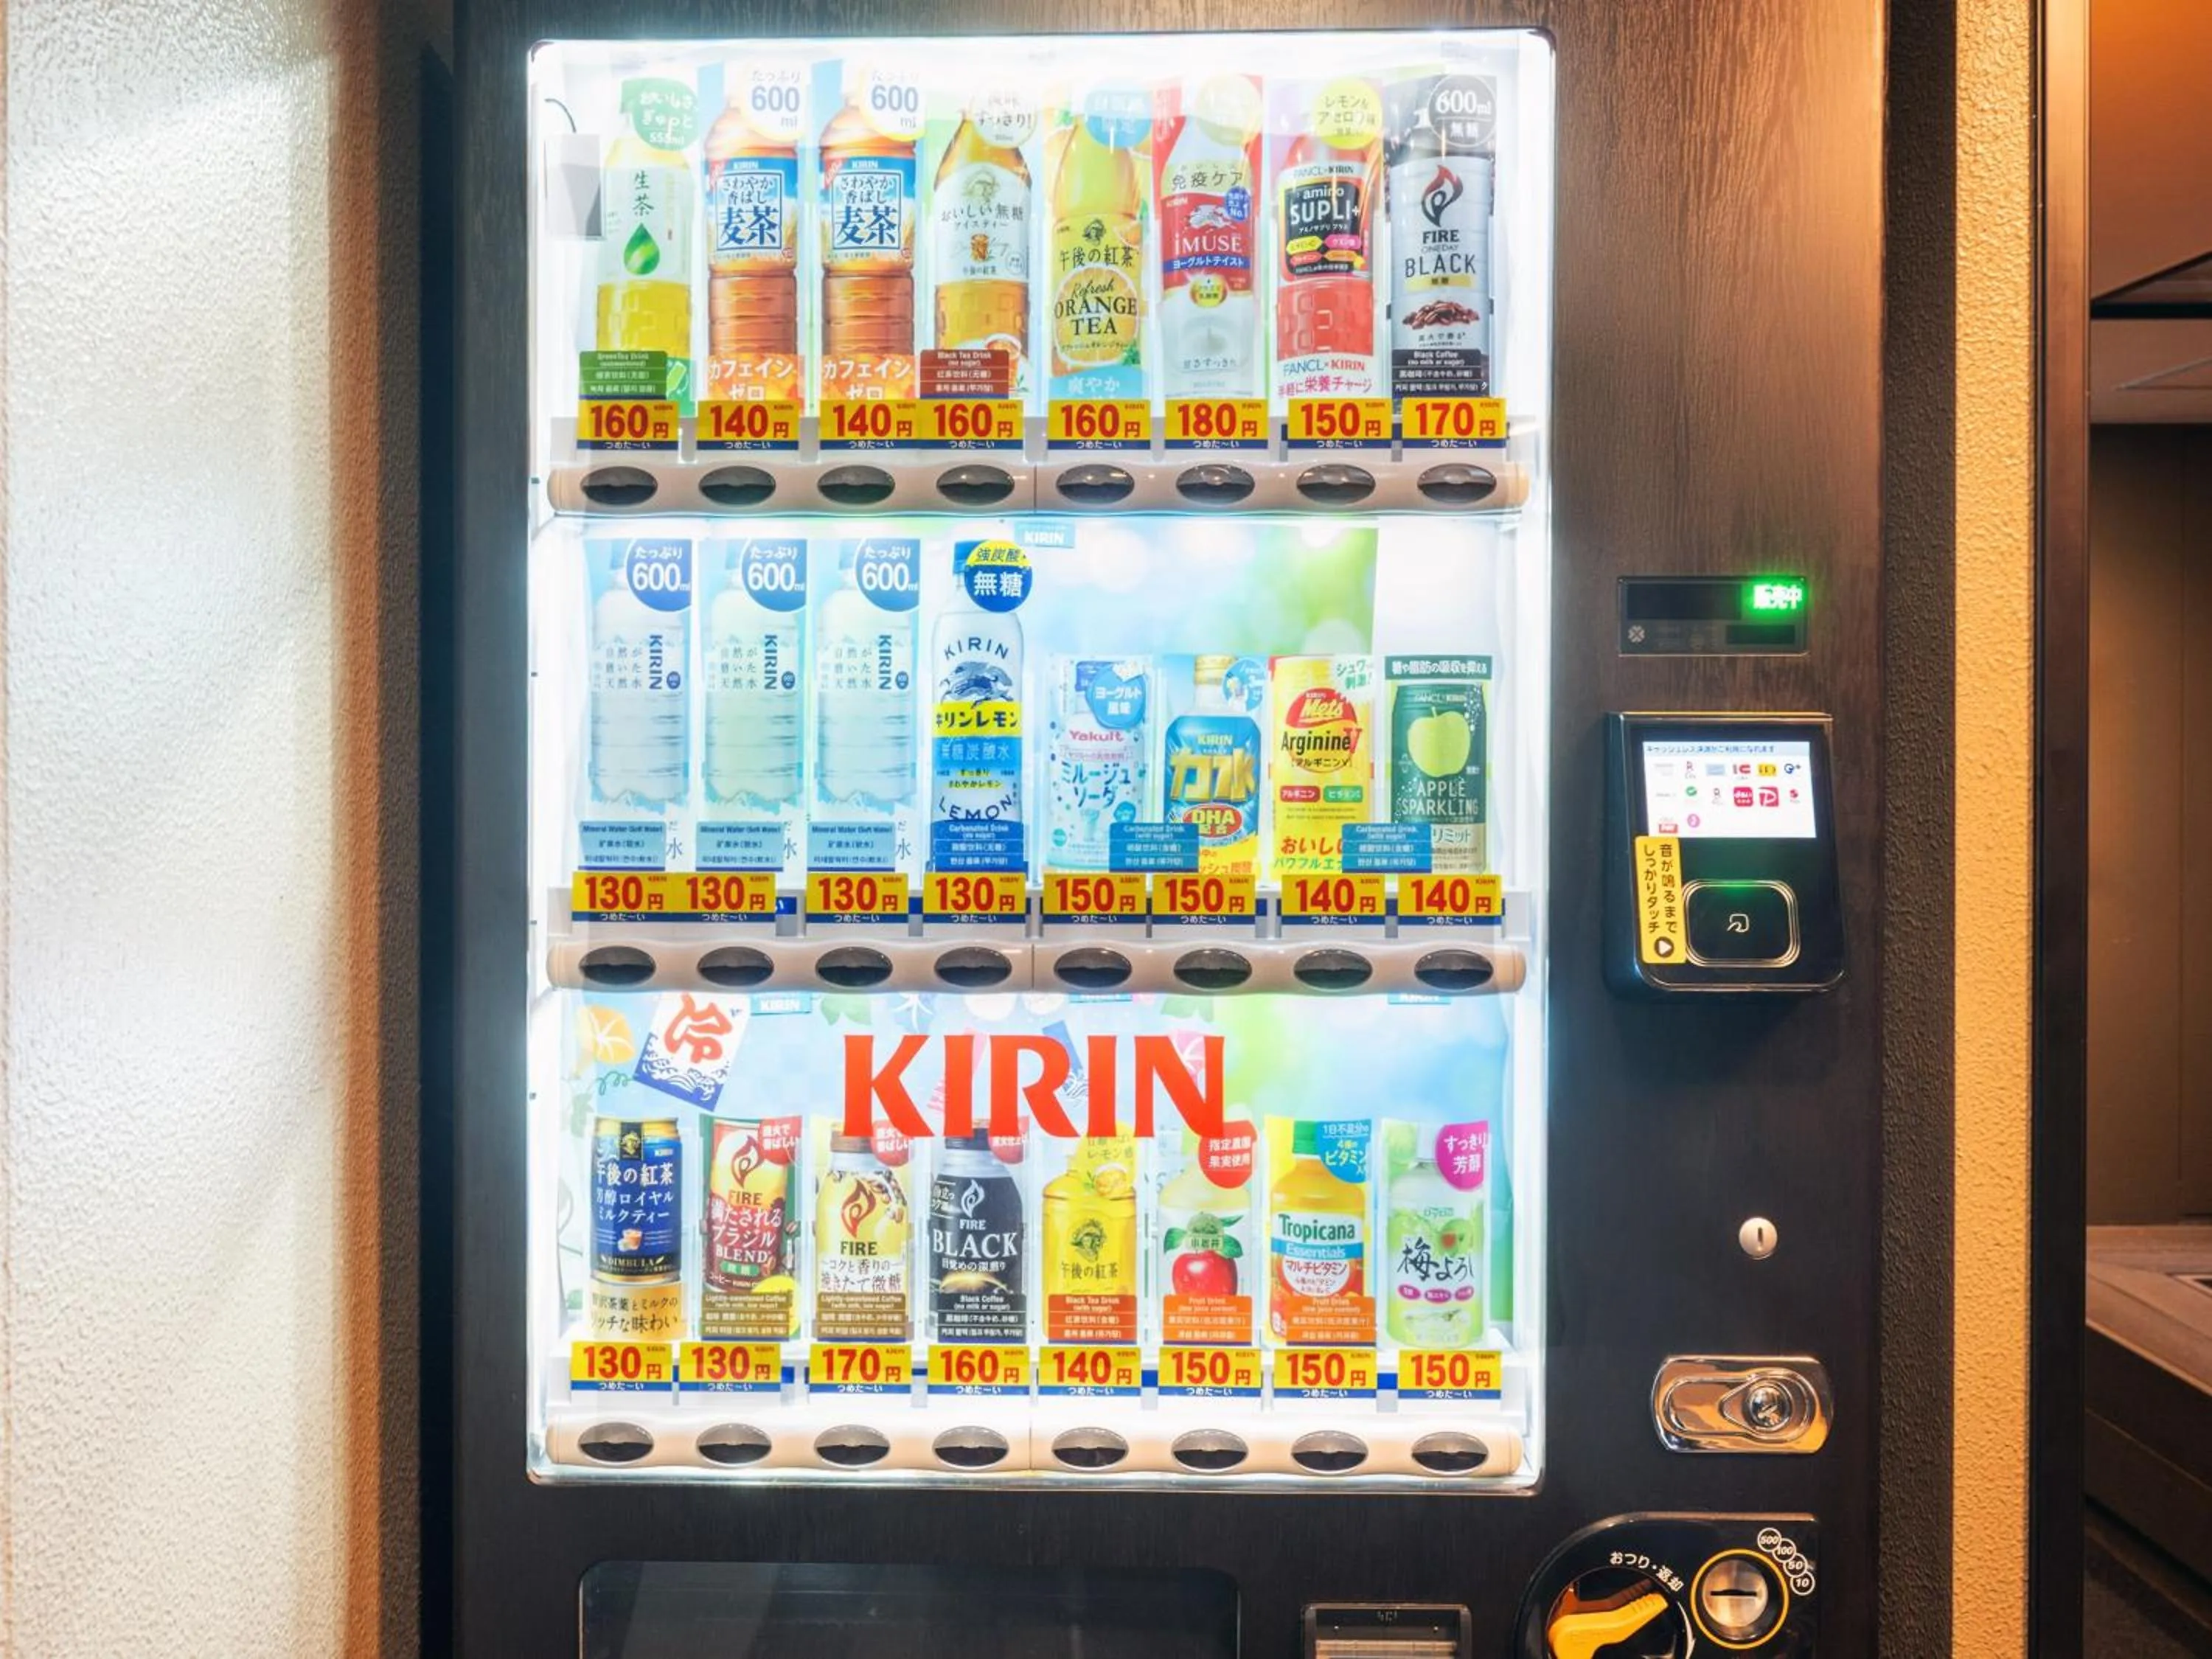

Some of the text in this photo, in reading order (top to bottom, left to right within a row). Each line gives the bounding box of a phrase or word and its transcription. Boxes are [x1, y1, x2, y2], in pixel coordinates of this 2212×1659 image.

[751, 85, 801, 113] 600
[871, 85, 919, 113] 600
[733, 161, 759, 170] KIRIN
[852, 160, 878, 170] KIRIN
[1171, 171, 1243, 190] 免疫ケア
[633, 169, 655, 218] 生茶
[718, 205, 779, 246] 麦茶
[835, 205, 897, 245] 麦茶
[1422, 229, 1461, 244] FIRE
[1174, 233, 1243, 256] iMUSE
[1060, 245, 1136, 271] 午後の紅茶
[1172, 255, 1244, 271] ヨーグルトテイスト
[1405, 253, 1477, 278] BLACK
[1054, 295, 1138, 319] ORANGE
[1071, 317, 1118, 335] TEA
[708, 358, 794, 379] カフェイン
[823, 359, 911, 379] カフェイン
[1330, 359, 1366, 372] KIRIN
[728, 385, 765, 400] ゼロ
[846, 384, 883, 400] ゼロ
[1068, 376, 1120, 394] 爽やか
[591, 405, 669, 438] 160円
[711, 405, 789, 438] 140円
[833, 404, 912, 437] 140円
[934, 404, 1013, 437] 160円
[1061, 404, 1141, 437] 160円
[1178, 403, 1257, 437] 180円
[1301, 403, 1382, 437] 150円
[1416, 403, 1496, 437] 170円
[1024, 530, 1065, 543] KIRIN
[635, 546, 683, 560] たっぷり
[749, 546, 798, 560] たっぷり
[863, 546, 911, 560] たっぷり
[975, 547, 1019, 563] 強炭酸
[973, 570, 1023, 597] 無糖
[943, 636, 1009, 660] KIRIN
[649, 634, 664, 690] KIRIN
[764, 634, 778, 690] KIRIN
[878, 634, 892, 690] KIRIN
[1095, 686, 1142, 700] ヨーグルト
[936, 710, 1018, 728] キリンレモン
[1069, 729, 1124, 742] Yakult
[1196, 734, 1233, 745] KIRIN
[1074, 785, 1119, 808] ソーダ
[1416, 779, 1467, 798] APPLE
[938, 793, 1014, 821] LEMON
[1191, 810, 1236, 825] DHA
[585, 876, 663, 910] 130円
[686, 876, 765, 910] 130円
[818, 877, 897, 911] 130円
[936, 877, 1015, 911] 130円
[1056, 878, 1135, 912] 150円
[1165, 878, 1245, 912] 150円
[1295, 879, 1376, 913] 140円
[1411, 879, 1491, 913] 140円
[1644, 844, 1660, 933] しっかりタッチ
[1659, 844, 1677, 933] 音が鳴るまで
[760, 998, 801, 1011] KIRIN
[843, 1034, 1226, 1138] KIRIN
[1444, 1134, 1489, 1153] すっきり
[1324, 1149, 1366, 1166] ビタミン
[1453, 1156, 1482, 1175] 芳醇
[597, 1162, 674, 1186] 午後の紅茶
[728, 1190, 763, 1206] FIRE
[598, 1210, 670, 1224] ミルクティー
[959, 1219, 987, 1231] FIRE
[1278, 1213, 1355, 1240] Tropicana
[711, 1224, 776, 1248] ブラジル
[932, 1228, 1018, 1259] BLACK
[715, 1244, 770, 1265] BLEND
[840, 1241, 877, 1256] FIRE
[1285, 1243, 1346, 1258] Essentials
[830, 1258, 891, 1275] コクと香りの
[1061, 1261, 1118, 1280] 午後の紅茶
[1285, 1259, 1348, 1275] マルチビタミン
[583, 1346, 661, 1380] 130円
[692, 1346, 771, 1380] 130円
[822, 1348, 901, 1382] 170円
[941, 1350, 1019, 1383] 160円
[1053, 1351, 1132, 1384] 140円
[1172, 1352, 1251, 1385] 150円
[1287, 1353, 1366, 1386] 150円
[1411, 1353, 1490, 1387] 150円
[1759, 1535, 1780, 1545] 500
[1775, 1545, 1793, 1556] 100
[1610, 1551, 1685, 1593] おつり・返却
[1788, 1559, 1803, 1571] 50
[1794, 1577, 1809, 1587] 10
